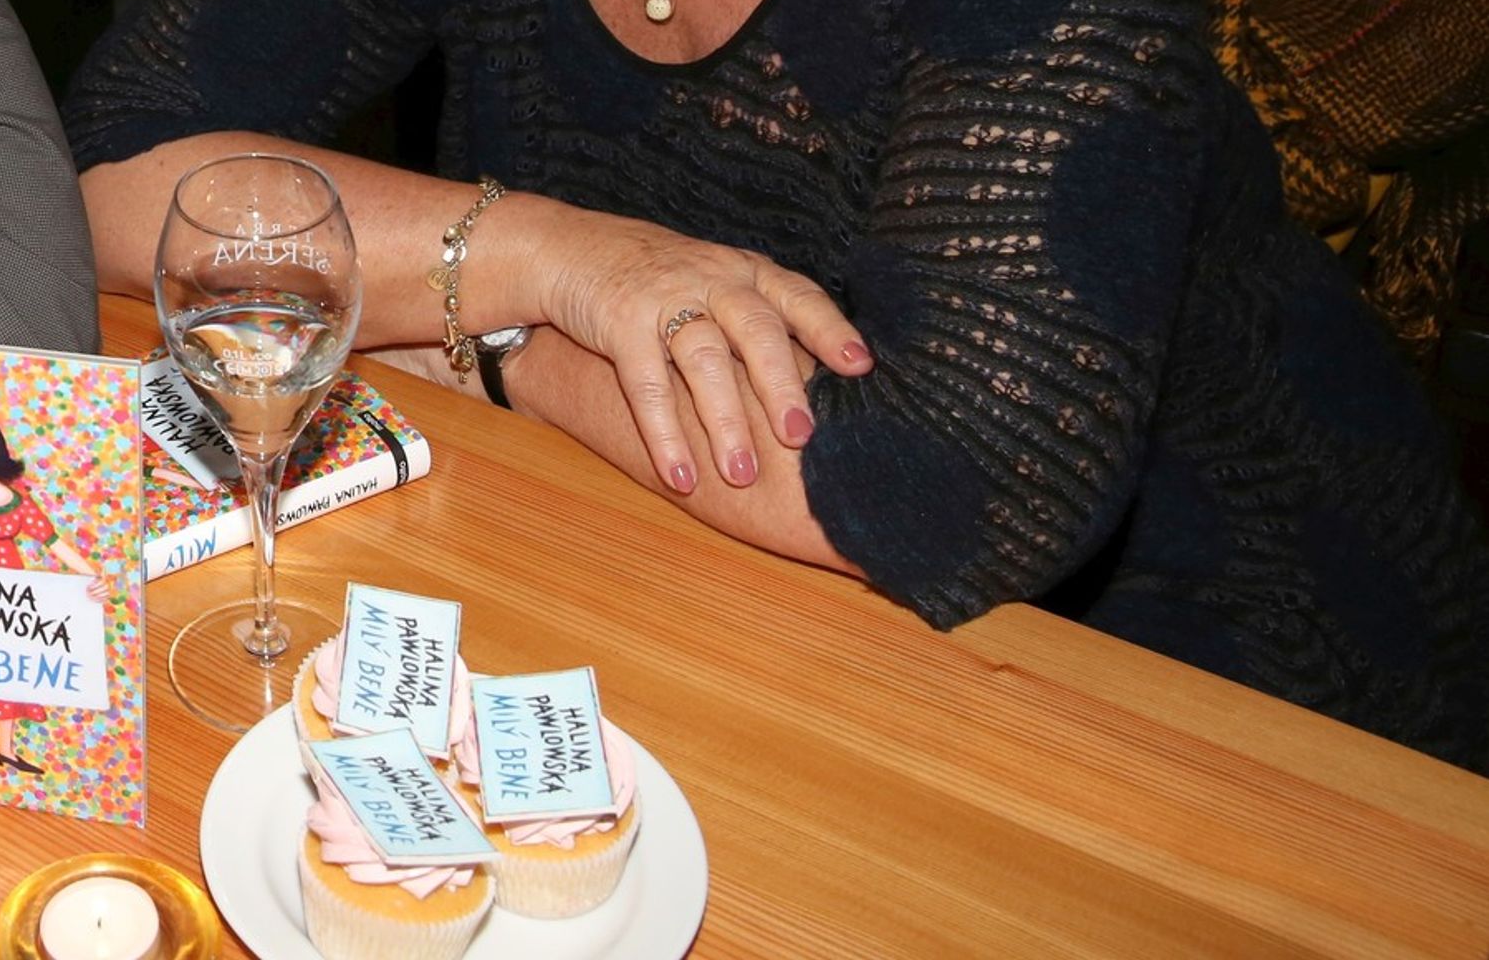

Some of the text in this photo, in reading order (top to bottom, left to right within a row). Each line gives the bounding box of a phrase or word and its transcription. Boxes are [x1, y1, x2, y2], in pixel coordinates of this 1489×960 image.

[274, 476, 378, 527] HALINA PAWLOWS
[352, 600, 392, 719] MILÝ BENE
[383, 616, 422, 725] PAWLOWSKÁ
[416, 637, 445, 708] HALINA
[482, 691, 535, 800] MILÝ BENE
[523, 694, 573, 795] PAWLOWSKÁ
[558, 707, 593, 773] HALINA
[323, 752, 416, 846] MILÝ BENE
[399, 767, 458, 826] HALINA
